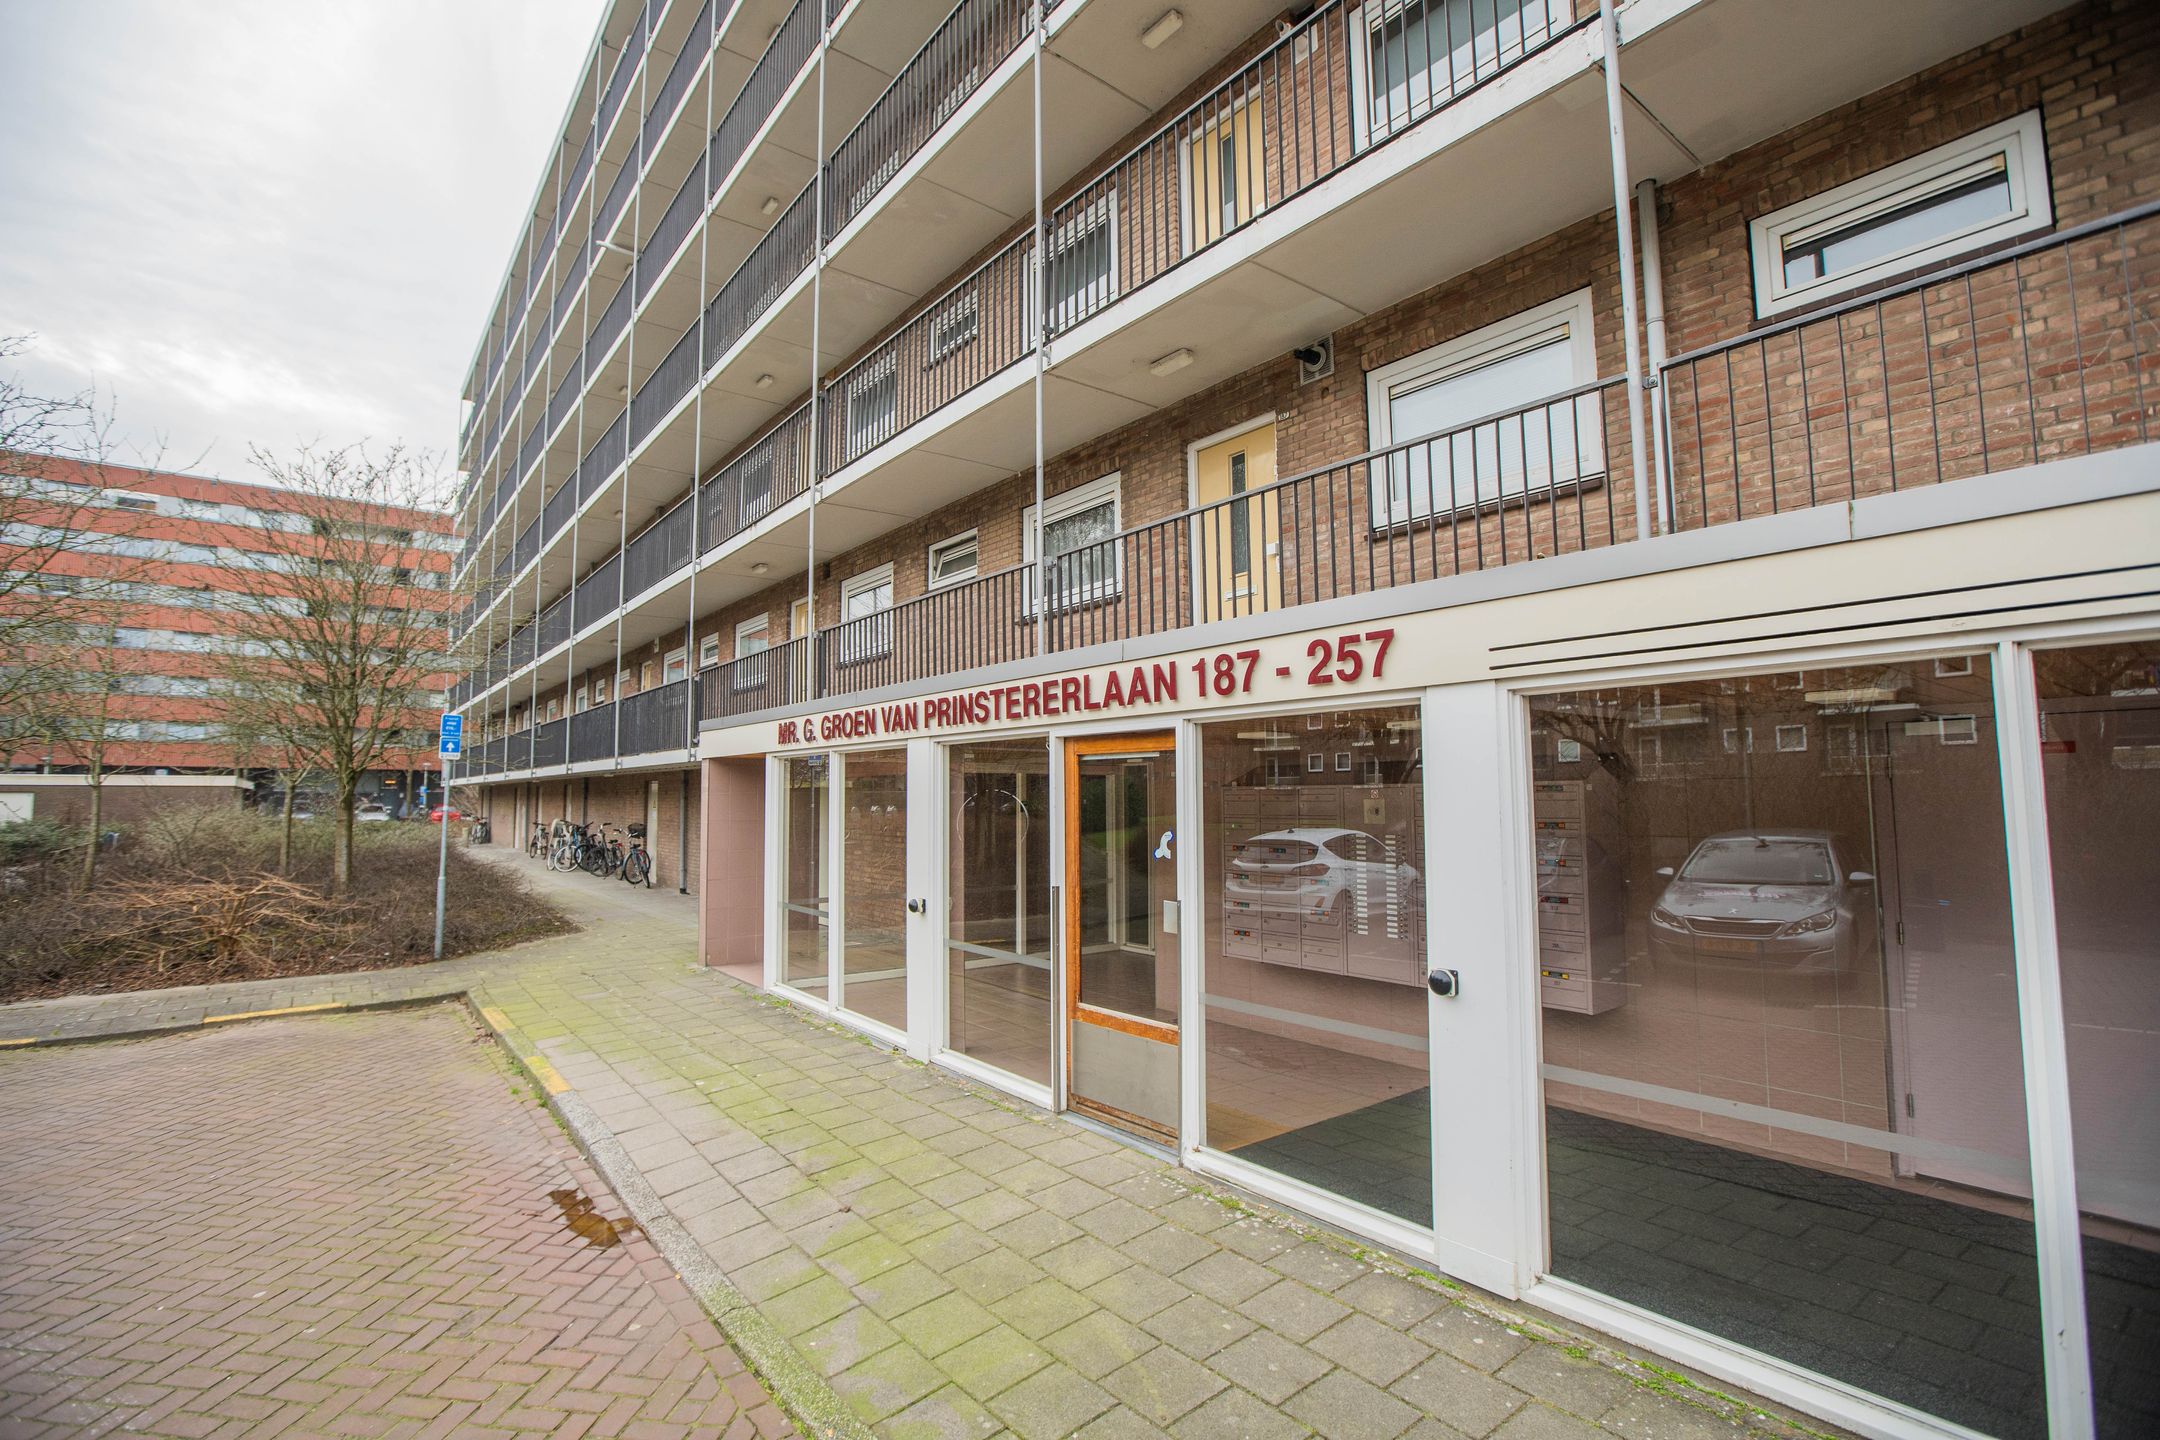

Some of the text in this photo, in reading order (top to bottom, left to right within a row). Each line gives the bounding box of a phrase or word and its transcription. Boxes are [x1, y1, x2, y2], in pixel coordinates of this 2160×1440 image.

[778, 628, 1394, 745] MR. G. GROEN VAN PRINSTERERLAAN 187 - 257
